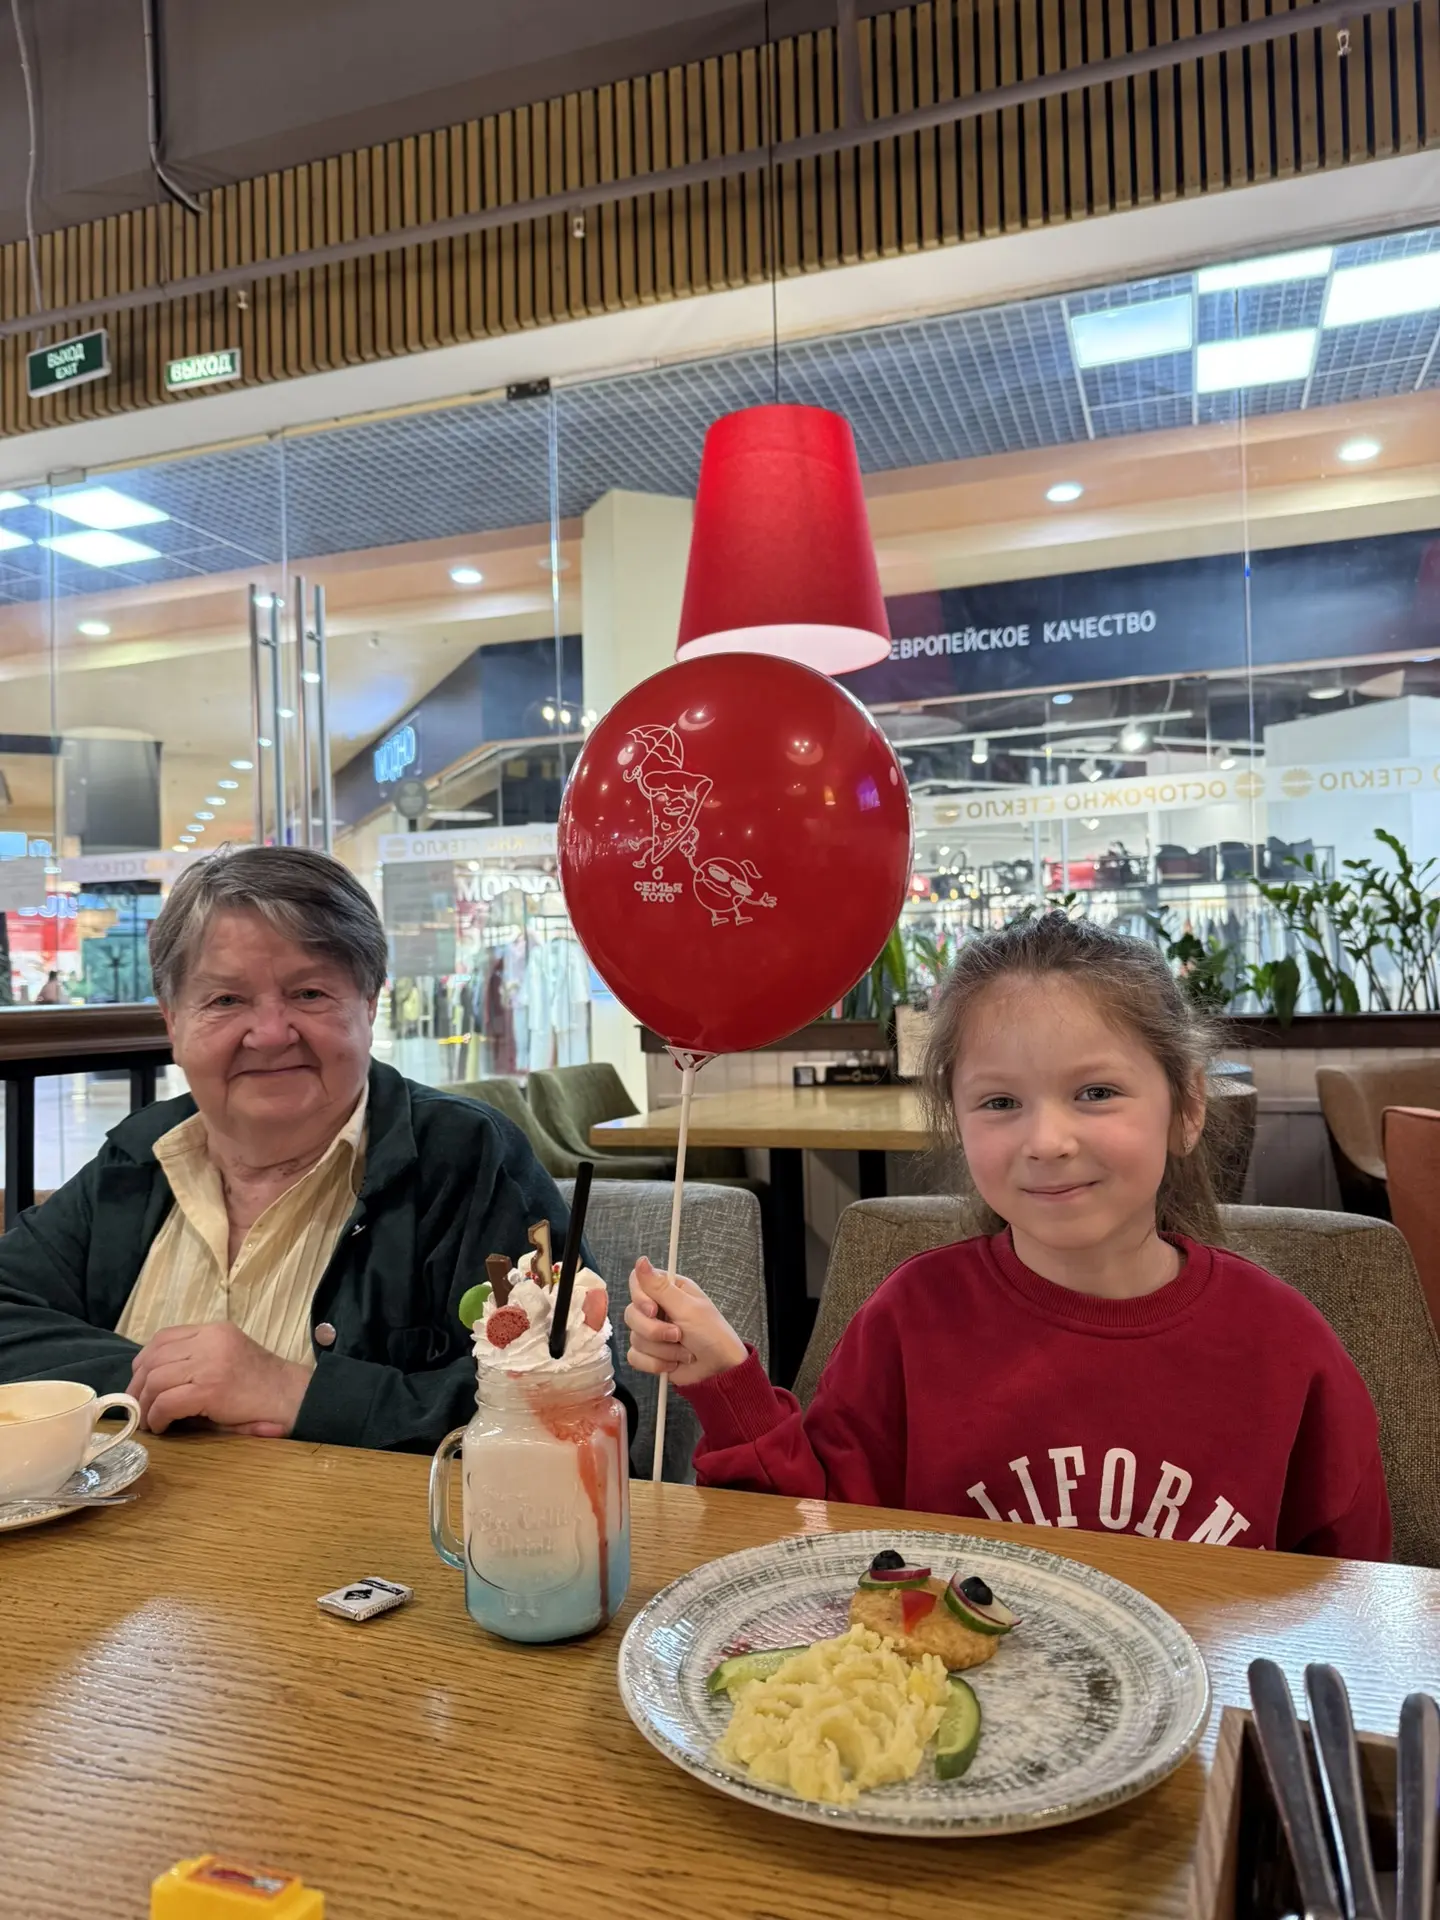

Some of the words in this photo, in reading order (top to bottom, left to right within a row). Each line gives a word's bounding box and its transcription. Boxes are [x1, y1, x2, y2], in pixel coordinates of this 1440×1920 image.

[55, 361, 78, 379] EXIT
[170, 354, 232, 382] ВЫХОД
[888, 624, 1030, 660] ЕВРОПЕЙСКОЕ
[1043, 610, 1157, 643] КАЧЕСТВО
[633, 881, 683, 893] СЕМЬЯ
[641, 891, 675, 903] ТОТО
[966, 1446, 1266, 1550] LIFORN
